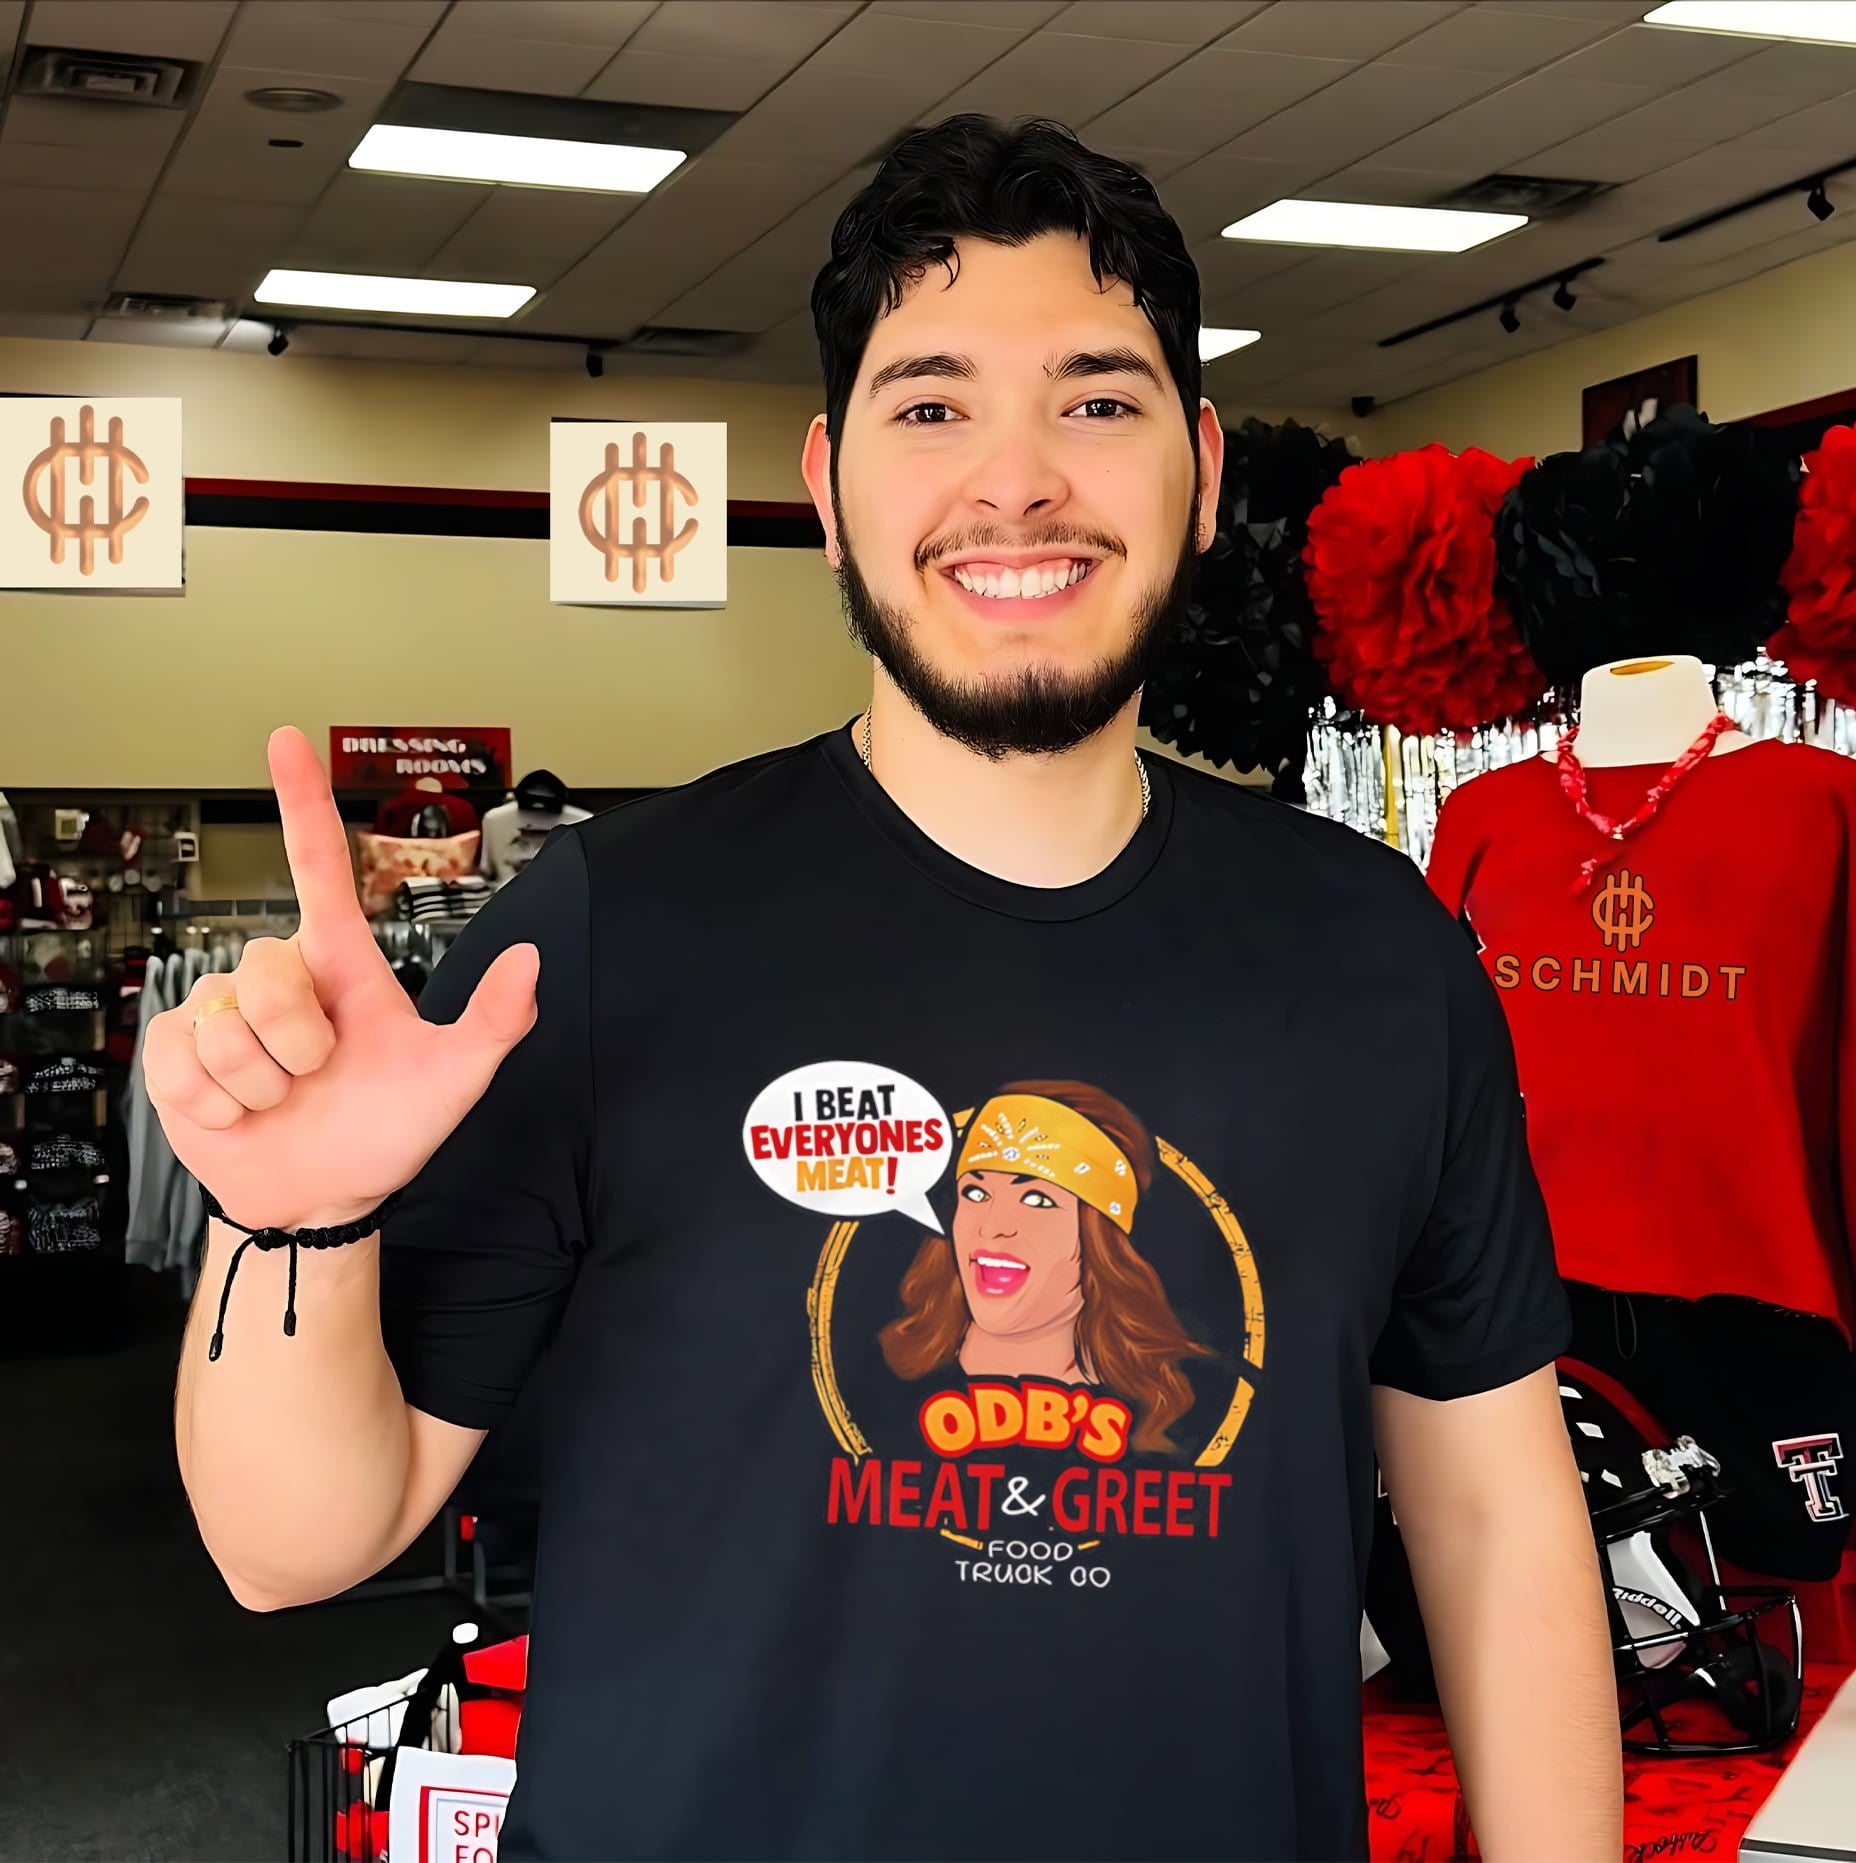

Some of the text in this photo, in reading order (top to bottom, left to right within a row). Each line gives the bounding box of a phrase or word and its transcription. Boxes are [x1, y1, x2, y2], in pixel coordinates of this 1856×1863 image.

[396, 758, 487, 774] ROOMS
[1494, 953, 1746, 1000] SCHMIDT
[793, 1084, 895, 1122] I BEAT
[750, 1118, 944, 1160] EVERYONES
[796, 1156, 898, 1195] MEAT!
[919, 1381, 1133, 1463] ODB'S
[827, 1457, 1232, 1537] MEAT & GREET
[988, 1540, 1073, 1562] FOOD
